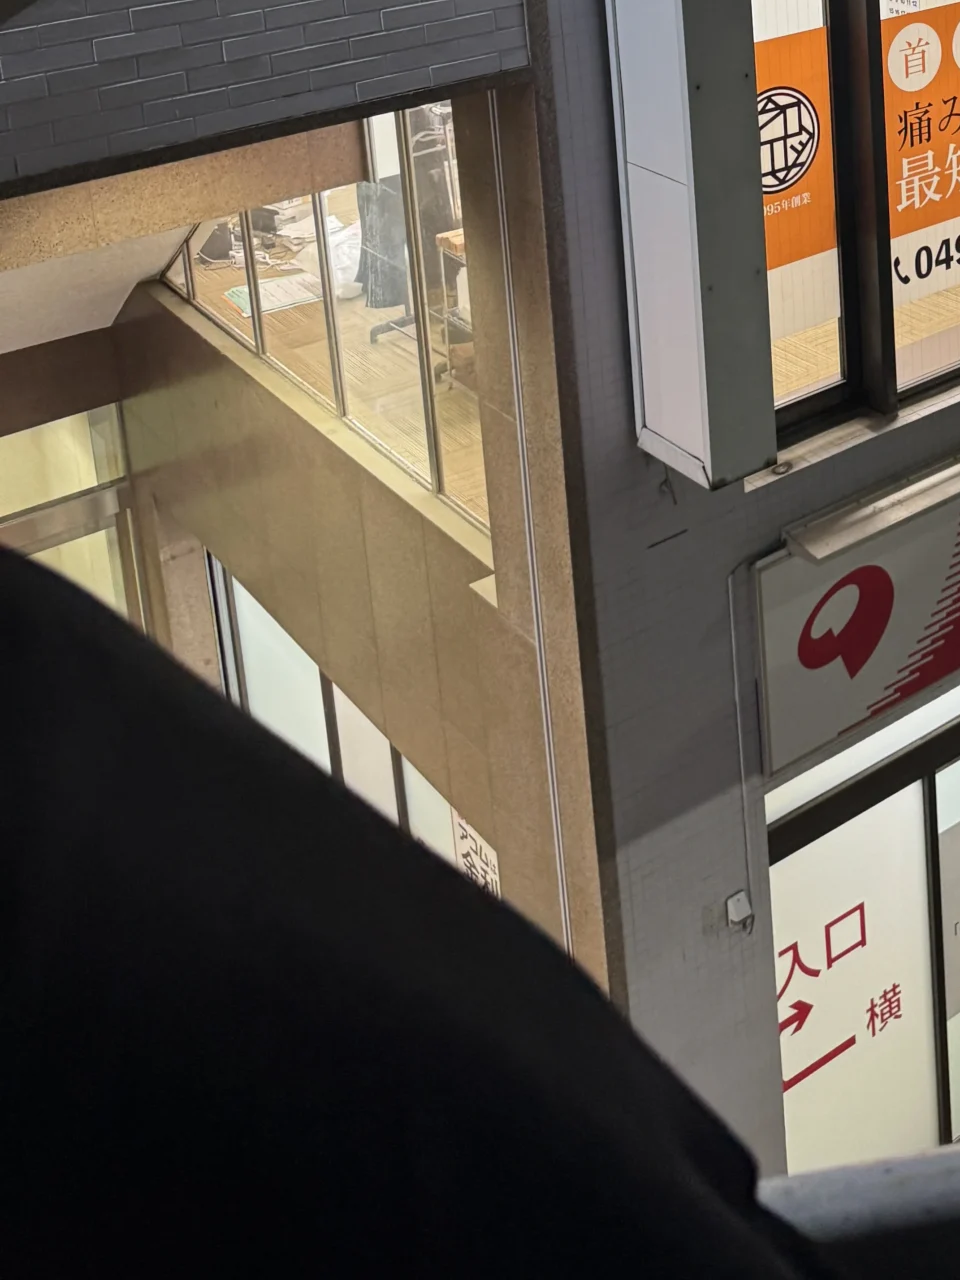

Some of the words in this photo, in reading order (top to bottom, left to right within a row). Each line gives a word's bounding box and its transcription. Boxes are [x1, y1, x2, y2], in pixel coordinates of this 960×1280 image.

[899, 37, 930, 79] 首
[763, 192, 811, 217] 95年創業
[777, 901, 866, 1002] 入口
[866, 983, 902, 1037] 横
